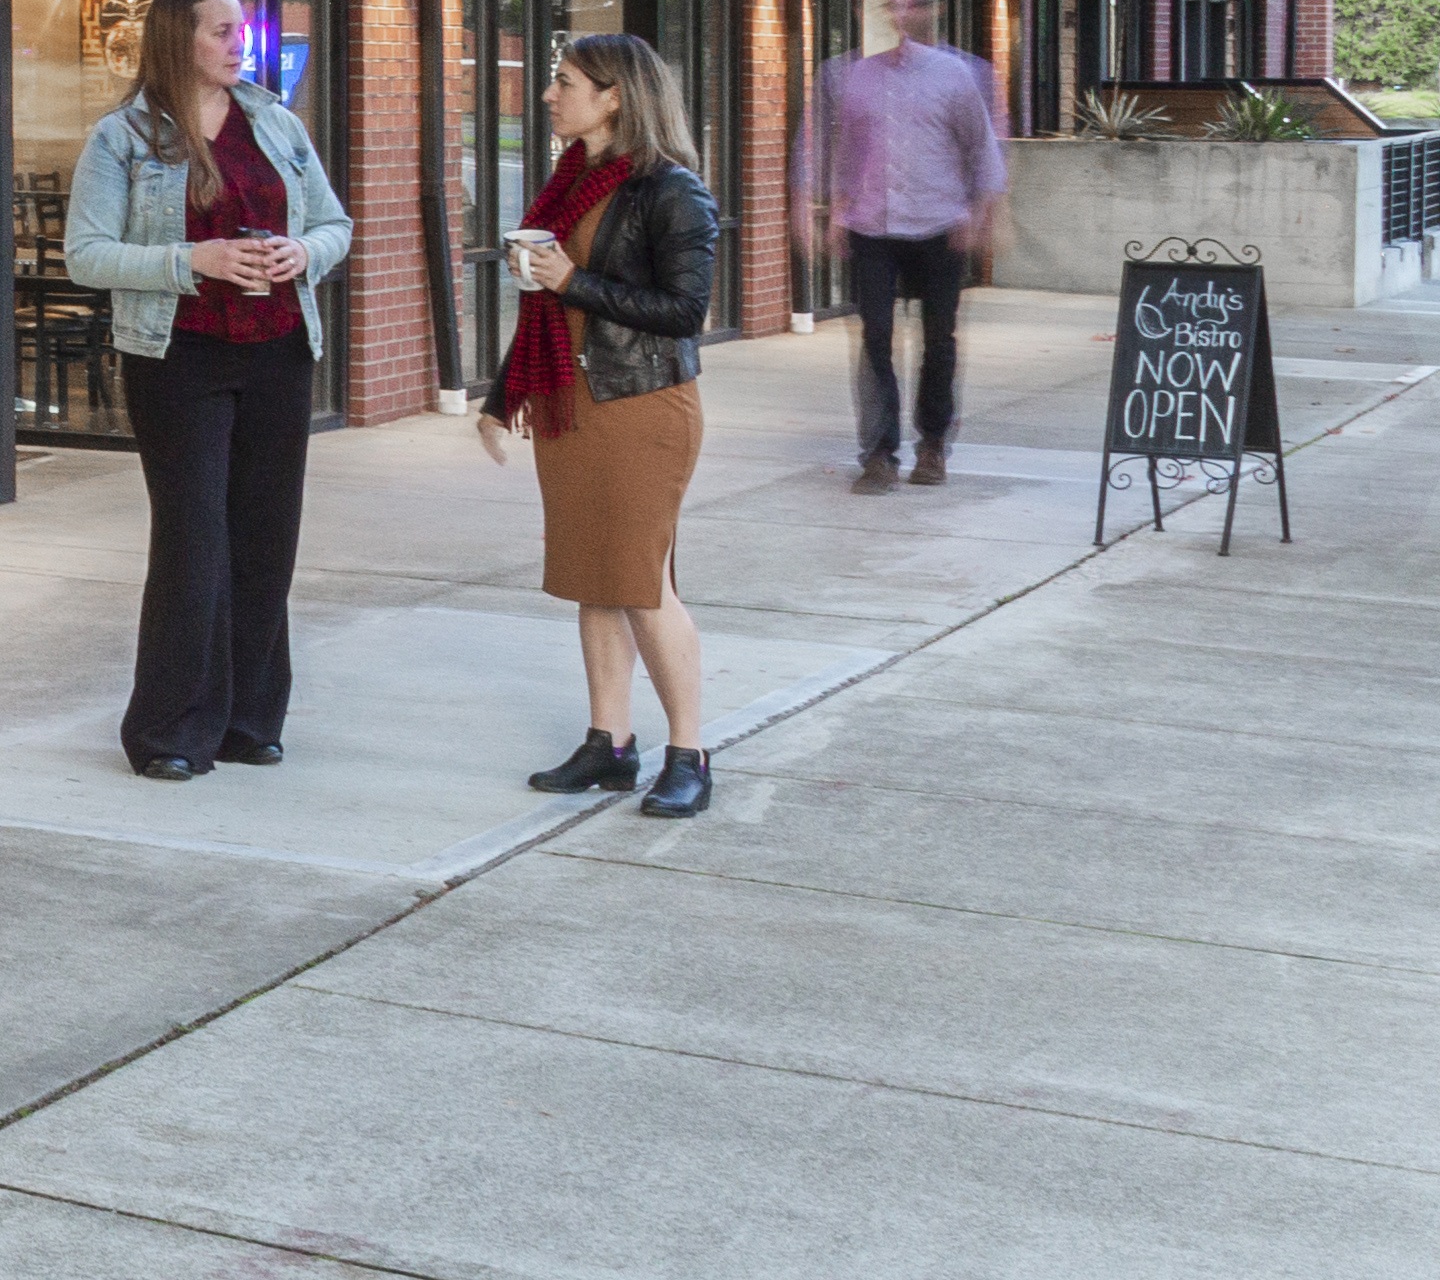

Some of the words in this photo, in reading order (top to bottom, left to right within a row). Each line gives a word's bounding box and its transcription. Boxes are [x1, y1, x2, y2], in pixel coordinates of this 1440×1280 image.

[1160, 278, 1244, 325] Andy's
[1174, 322, 1243, 348] Bistro
[1135, 350, 1242, 392] NOW
[1124, 389, 1236, 444] OPEN
